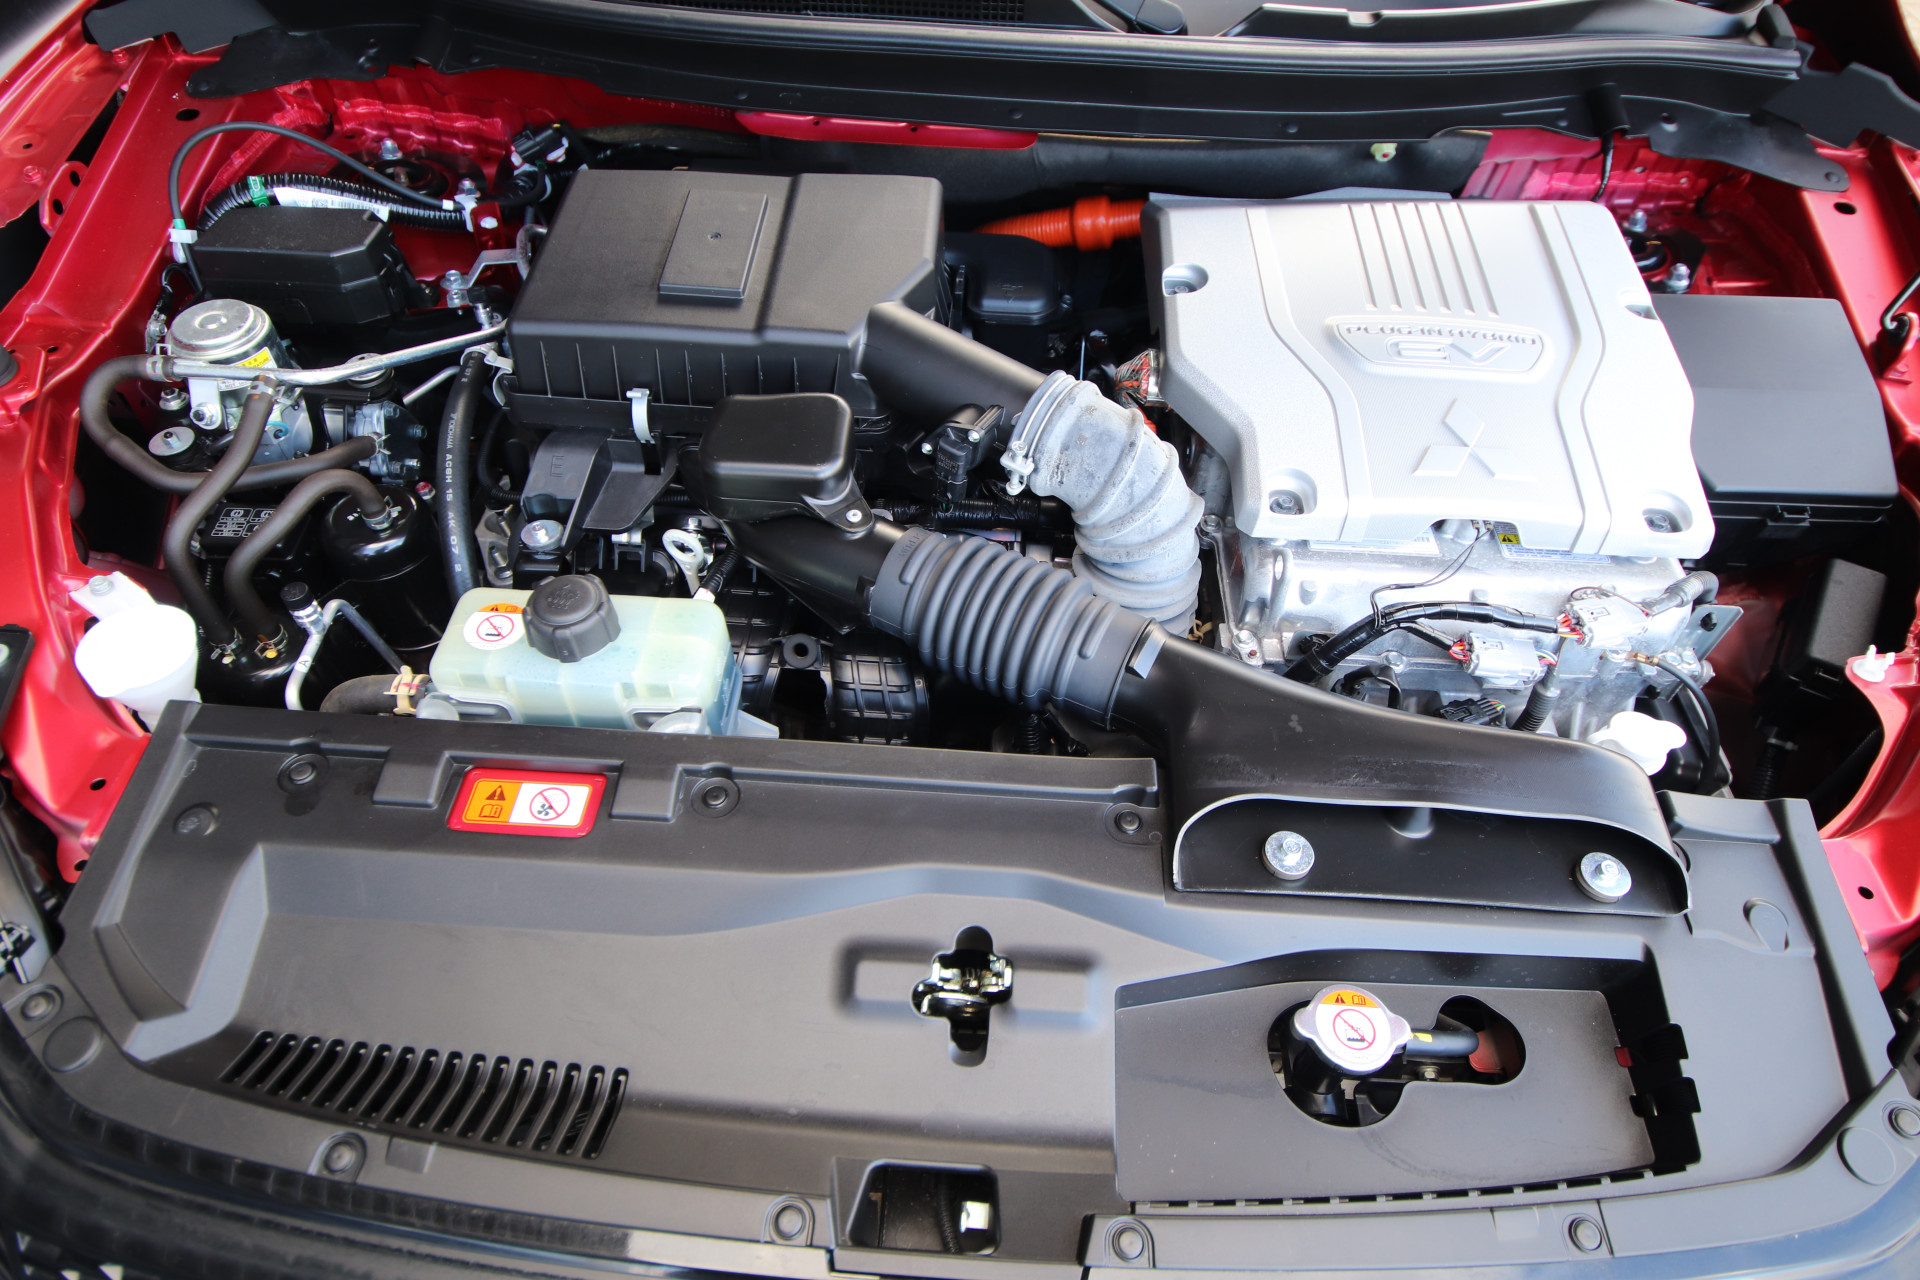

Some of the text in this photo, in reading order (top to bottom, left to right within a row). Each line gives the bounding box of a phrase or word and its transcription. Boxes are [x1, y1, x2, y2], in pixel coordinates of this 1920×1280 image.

[1346, 325, 1537, 345] PLUG-IN HYBRID
[1386, 337, 1511, 366] EV
[448, 511, 456, 527] AK
